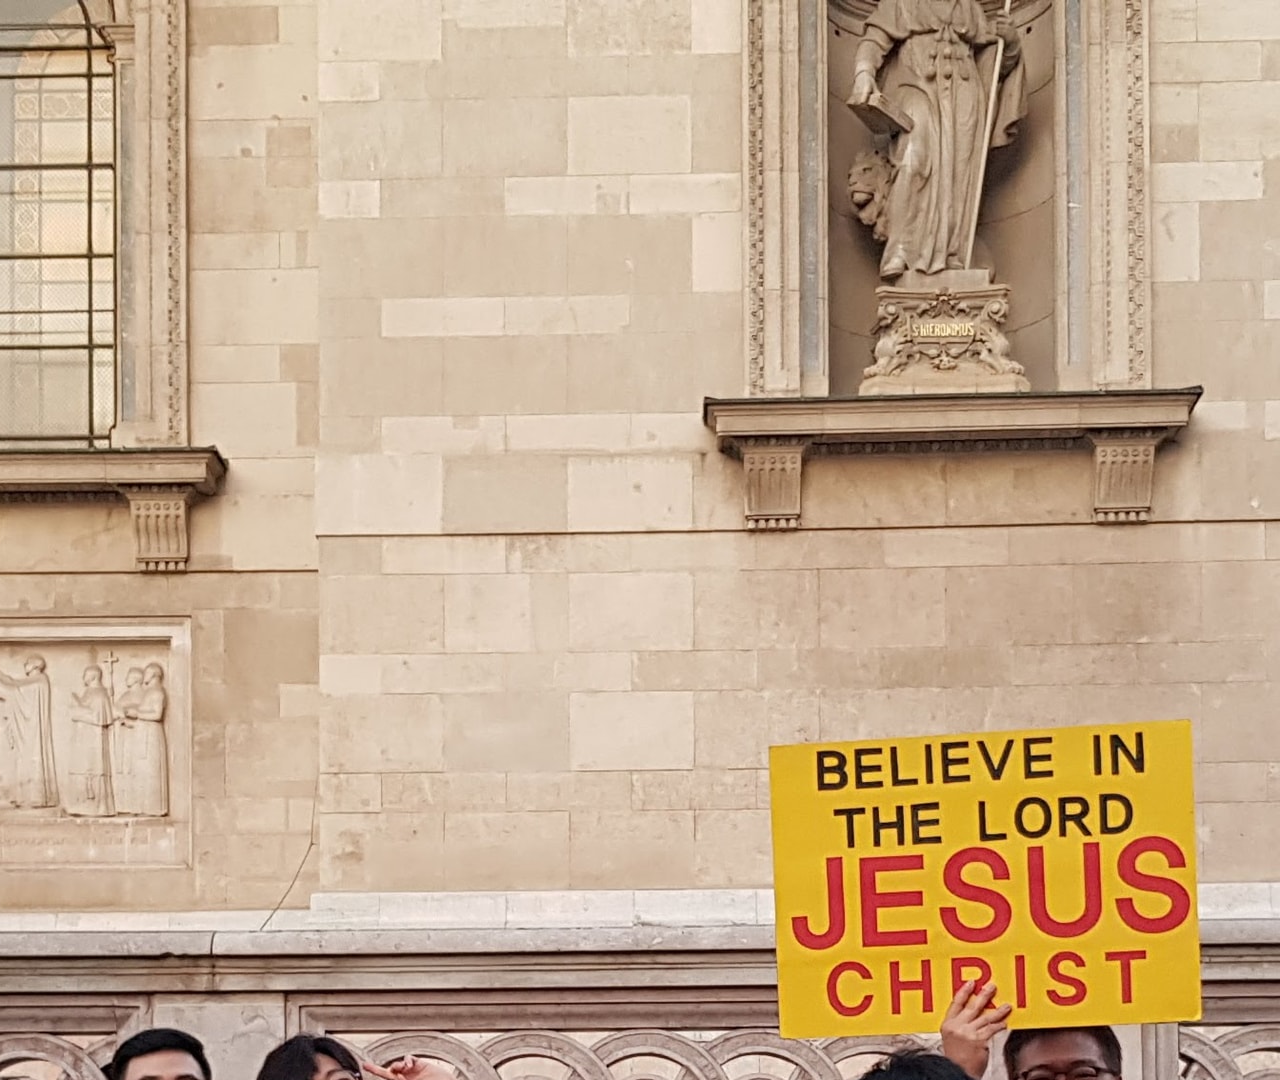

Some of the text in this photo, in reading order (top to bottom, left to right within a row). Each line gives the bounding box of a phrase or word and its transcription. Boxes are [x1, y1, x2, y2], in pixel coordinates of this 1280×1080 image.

[816, 731, 1146, 792] BELIEVE IN
[833, 793, 1134, 849] THE LORD
[791, 835, 1192, 951] JESUS
[826, 949, 1148, 1018] CHRIST
